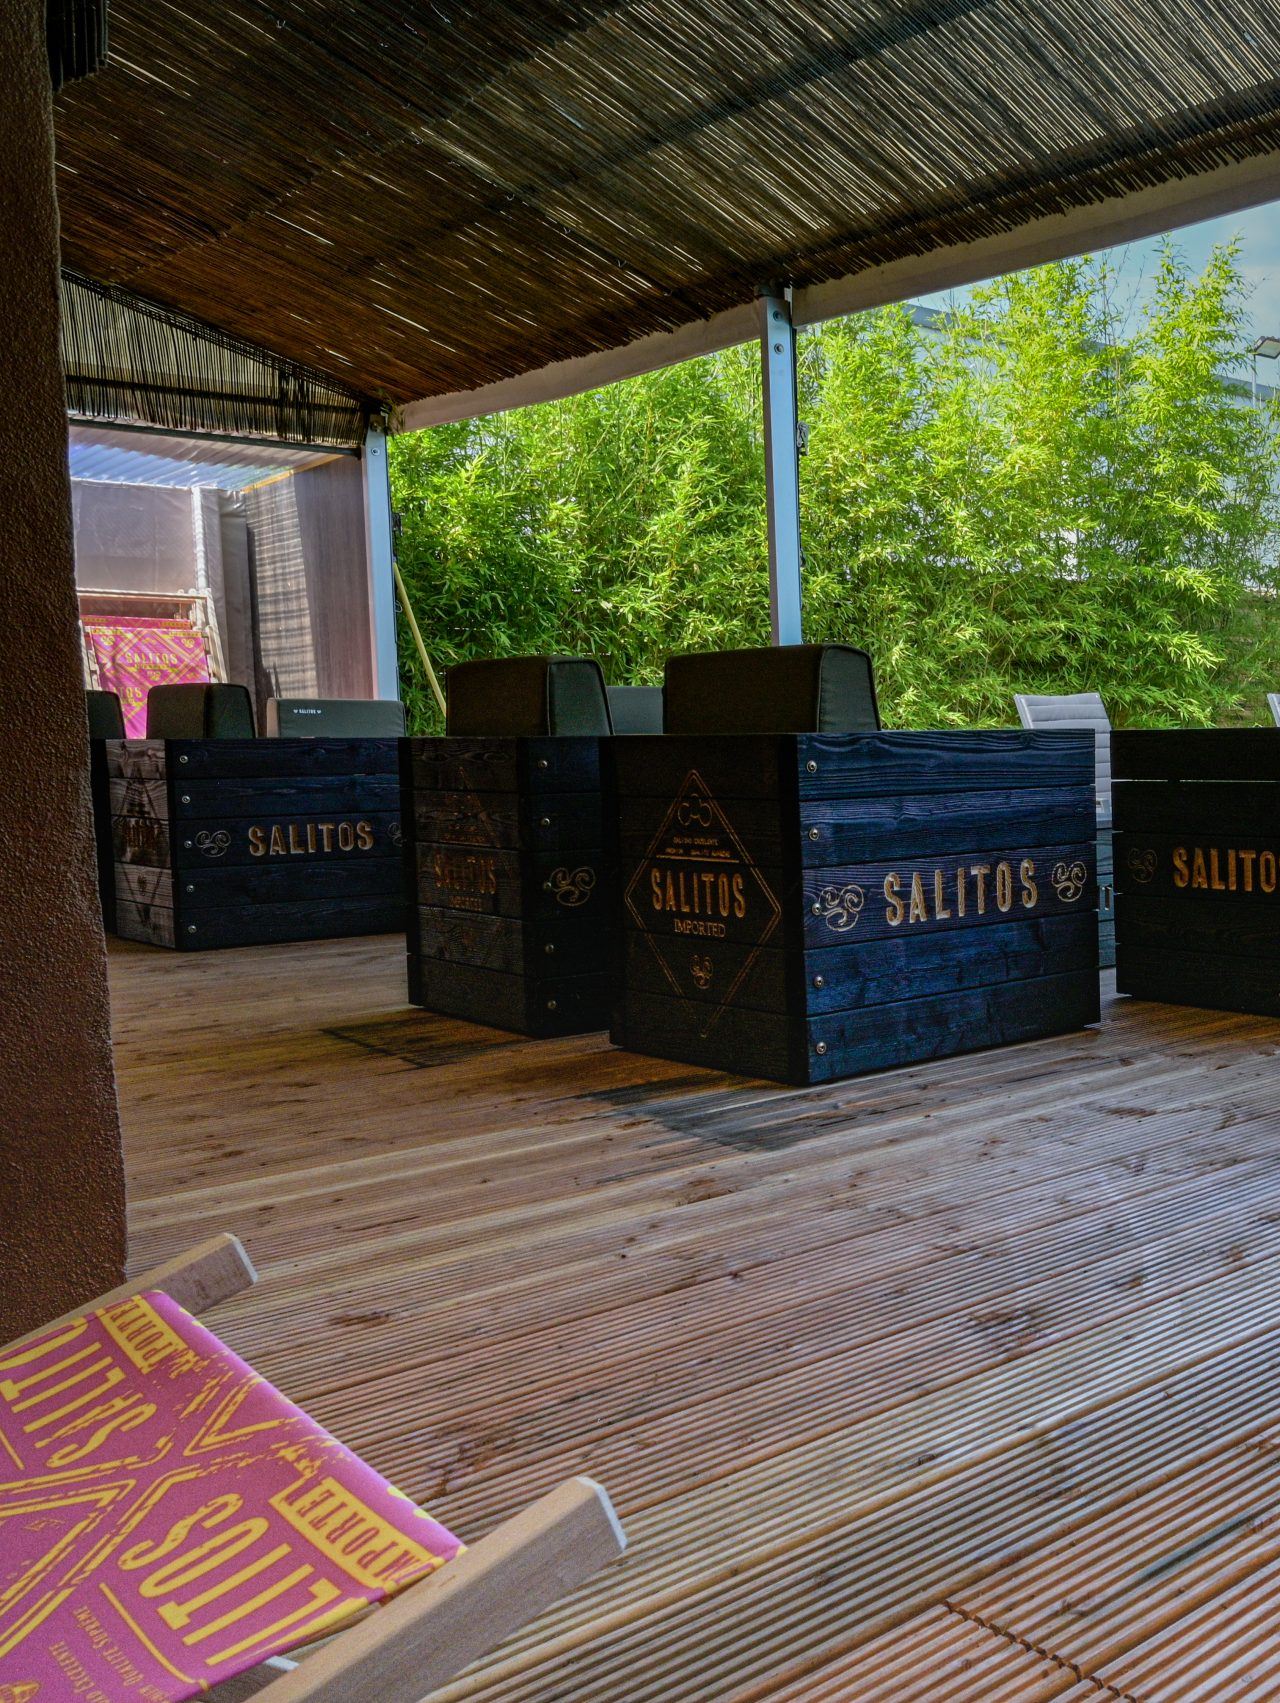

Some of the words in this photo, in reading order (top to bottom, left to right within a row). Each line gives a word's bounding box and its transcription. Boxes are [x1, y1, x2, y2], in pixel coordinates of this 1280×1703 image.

[248, 821, 375, 857] SALITOS
[651, 867, 745, 918] SALITOS
[883, 858, 1039, 926] SALITOS
